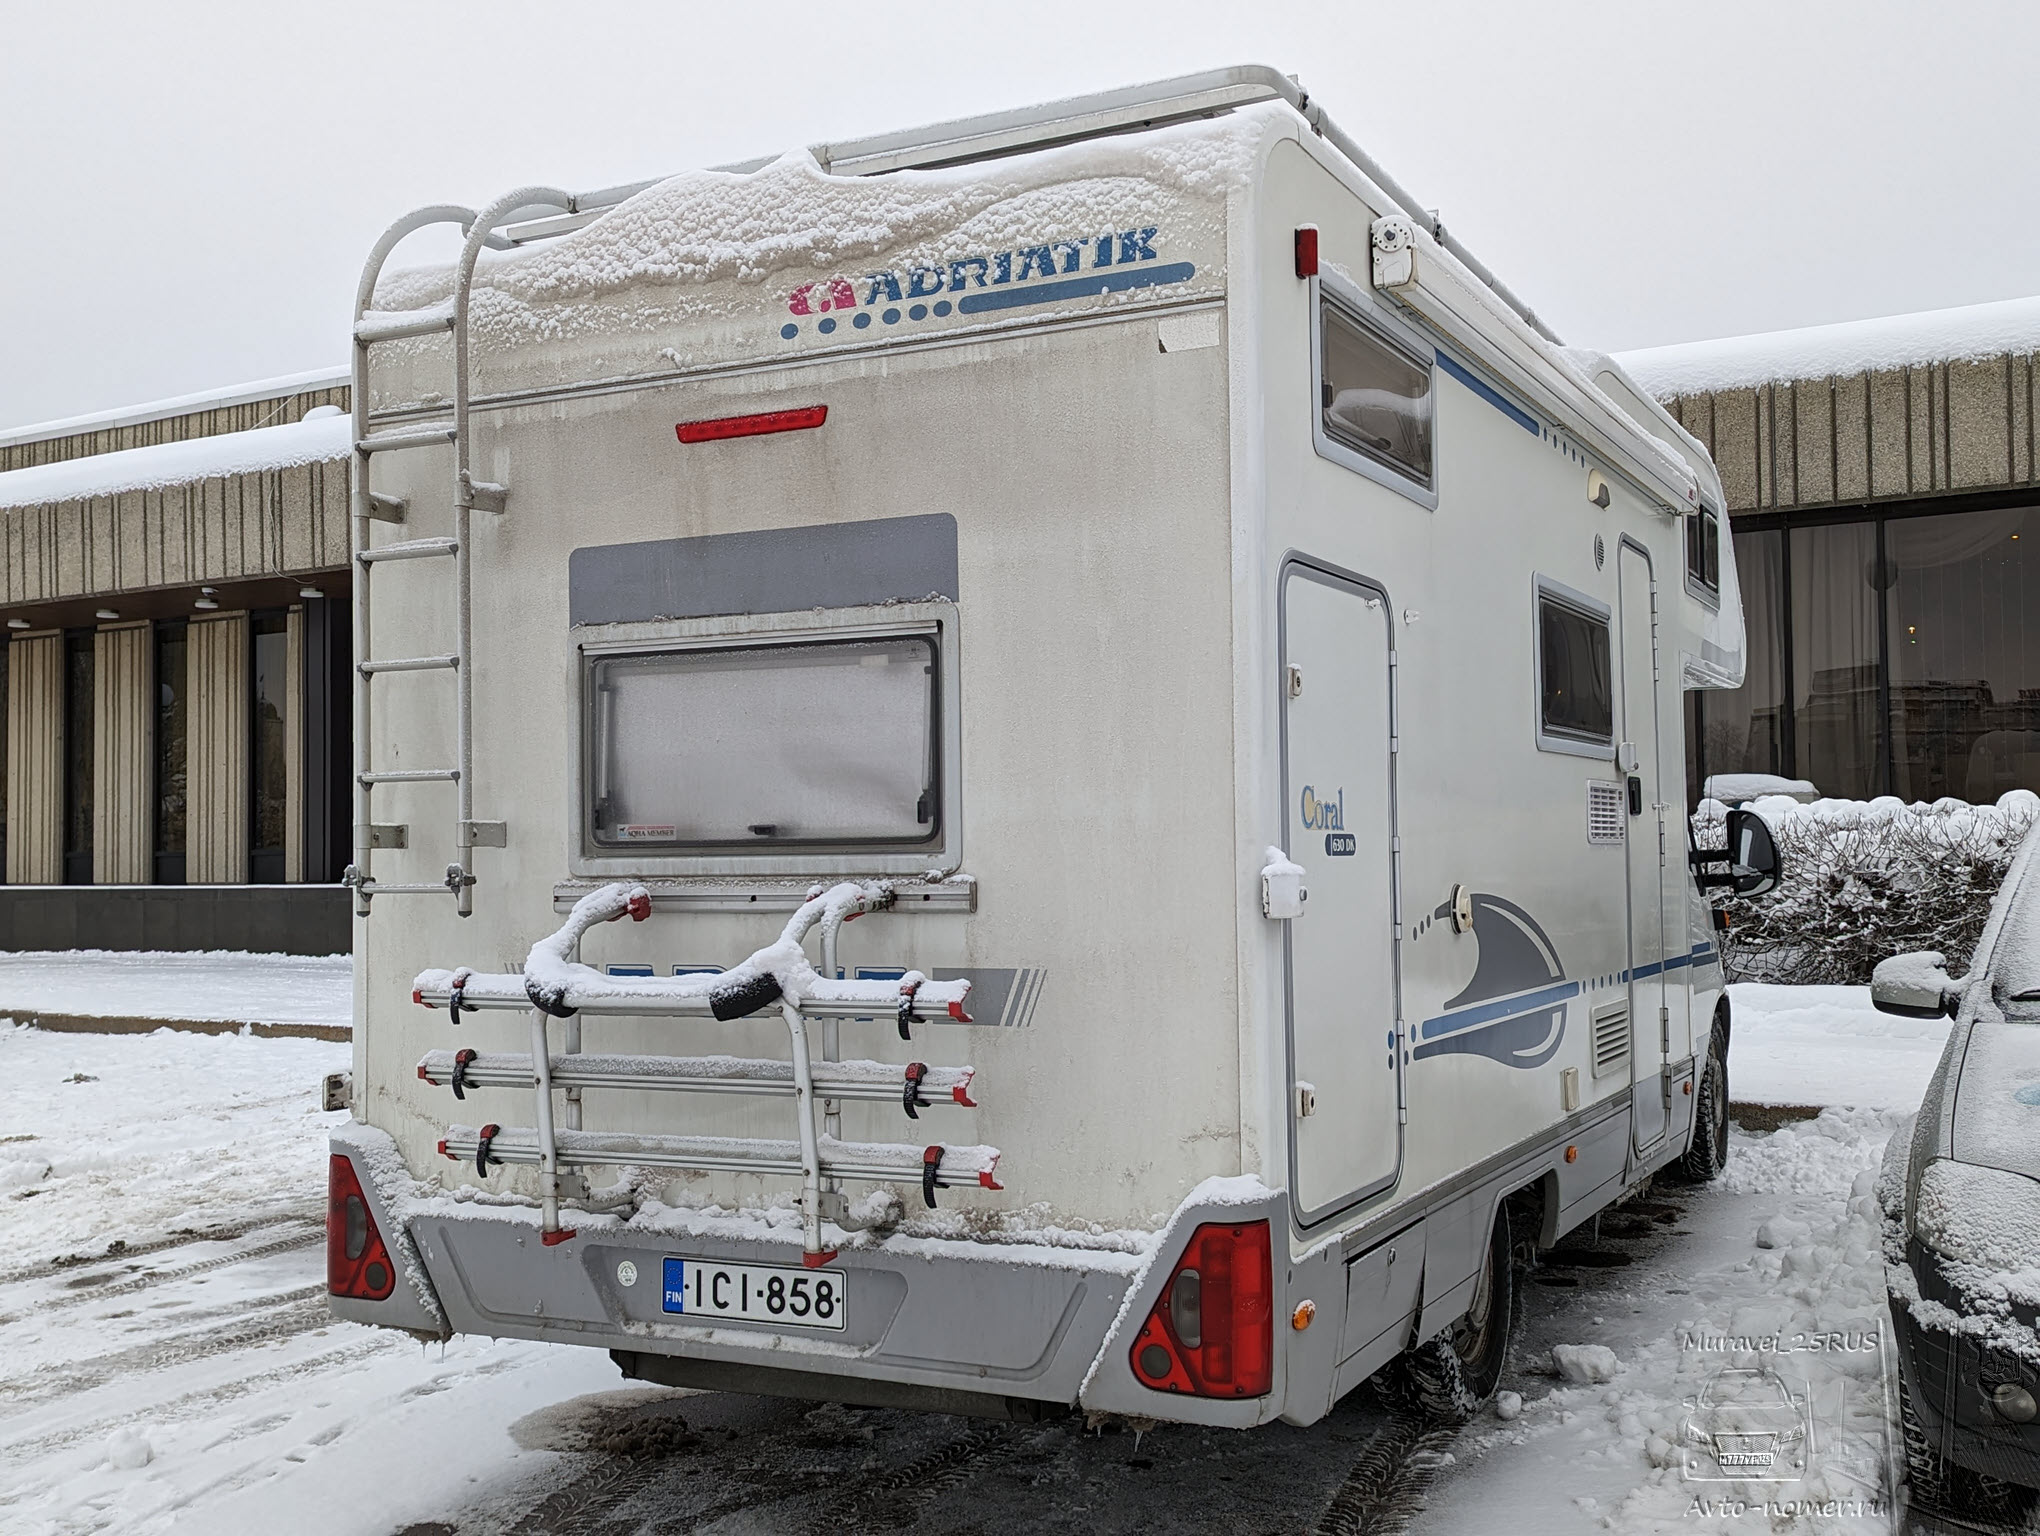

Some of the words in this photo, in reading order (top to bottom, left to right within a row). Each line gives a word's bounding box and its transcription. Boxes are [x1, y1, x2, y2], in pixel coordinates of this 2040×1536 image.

[865, 225, 1158, 306] ADRIATIK
[1301, 785, 1345, 831] Coral
[647, 829, 674, 837] MEMBER
[1332, 838, 1345, 852] 630
[1345, 838, 1355, 852] DK
[665, 1290, 682, 1304] FIN
